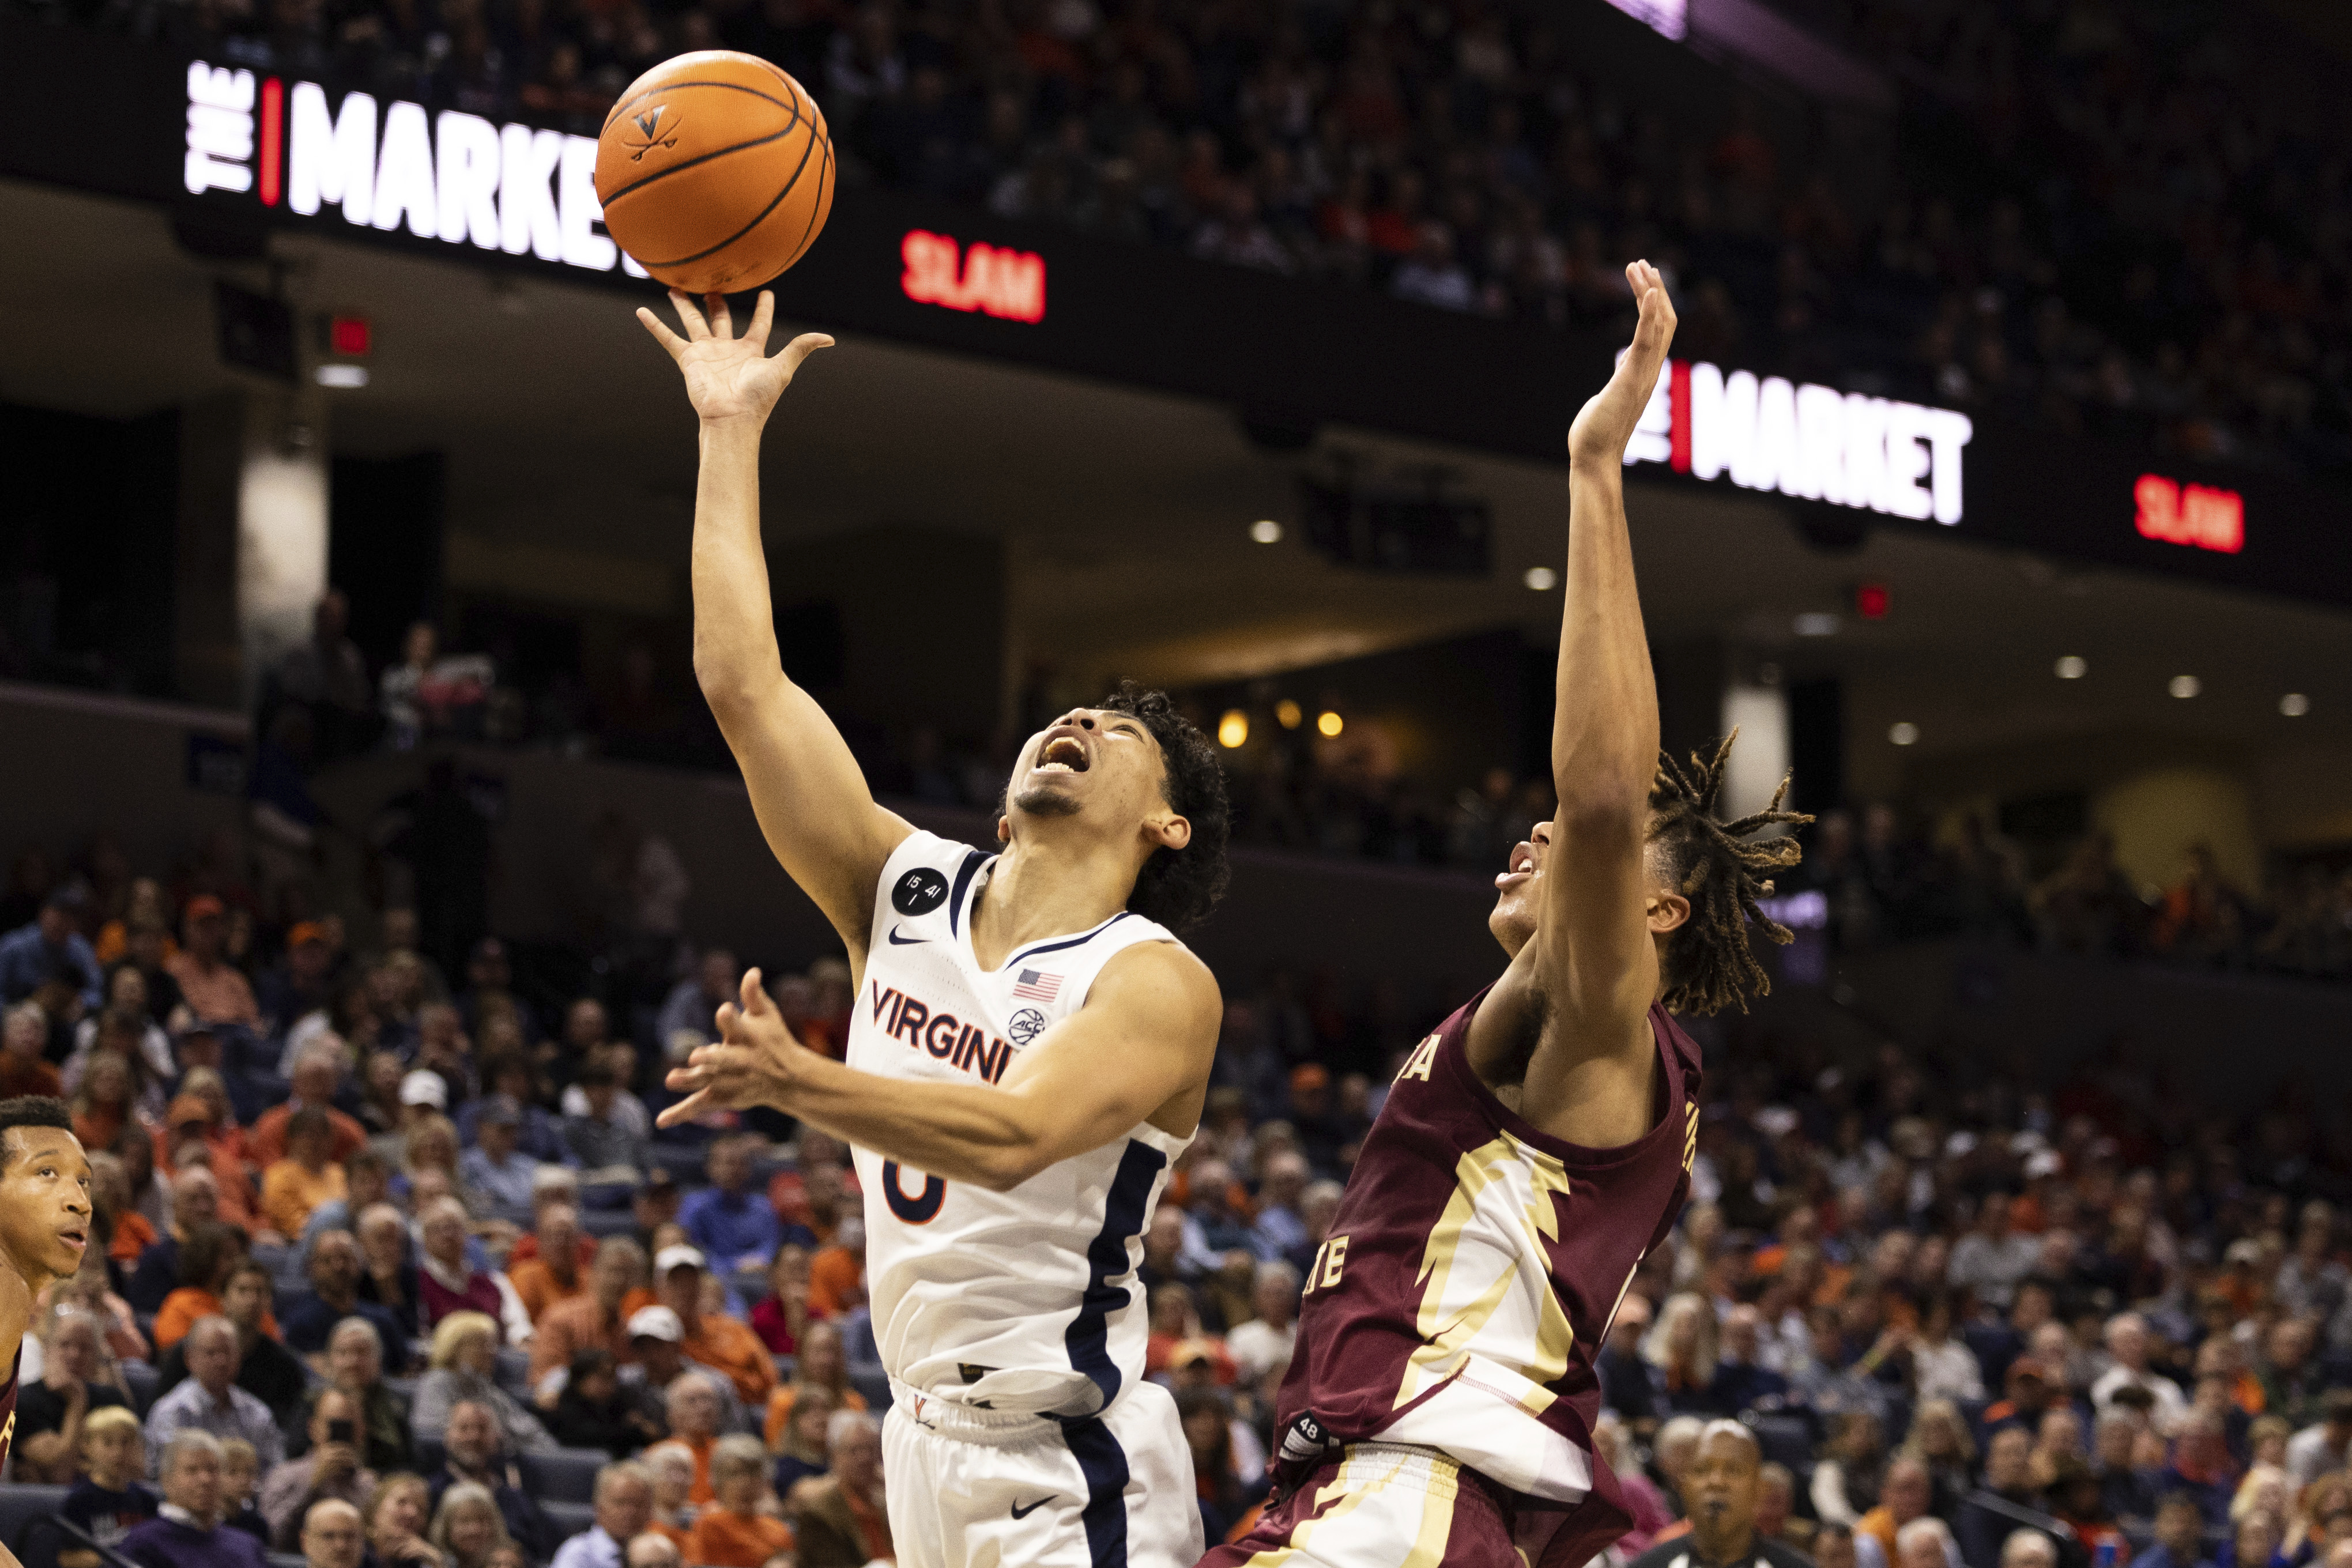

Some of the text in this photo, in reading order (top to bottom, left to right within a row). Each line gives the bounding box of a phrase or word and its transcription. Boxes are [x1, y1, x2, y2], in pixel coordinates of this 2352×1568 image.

[288, 81, 651, 279] MARKE
[1691, 361, 1973, 526] MARKET
[925, 885, 941, 898] 41
[872, 978, 1013, 1086] VIRGINI
[1299, 1418, 1318, 1439] 48
